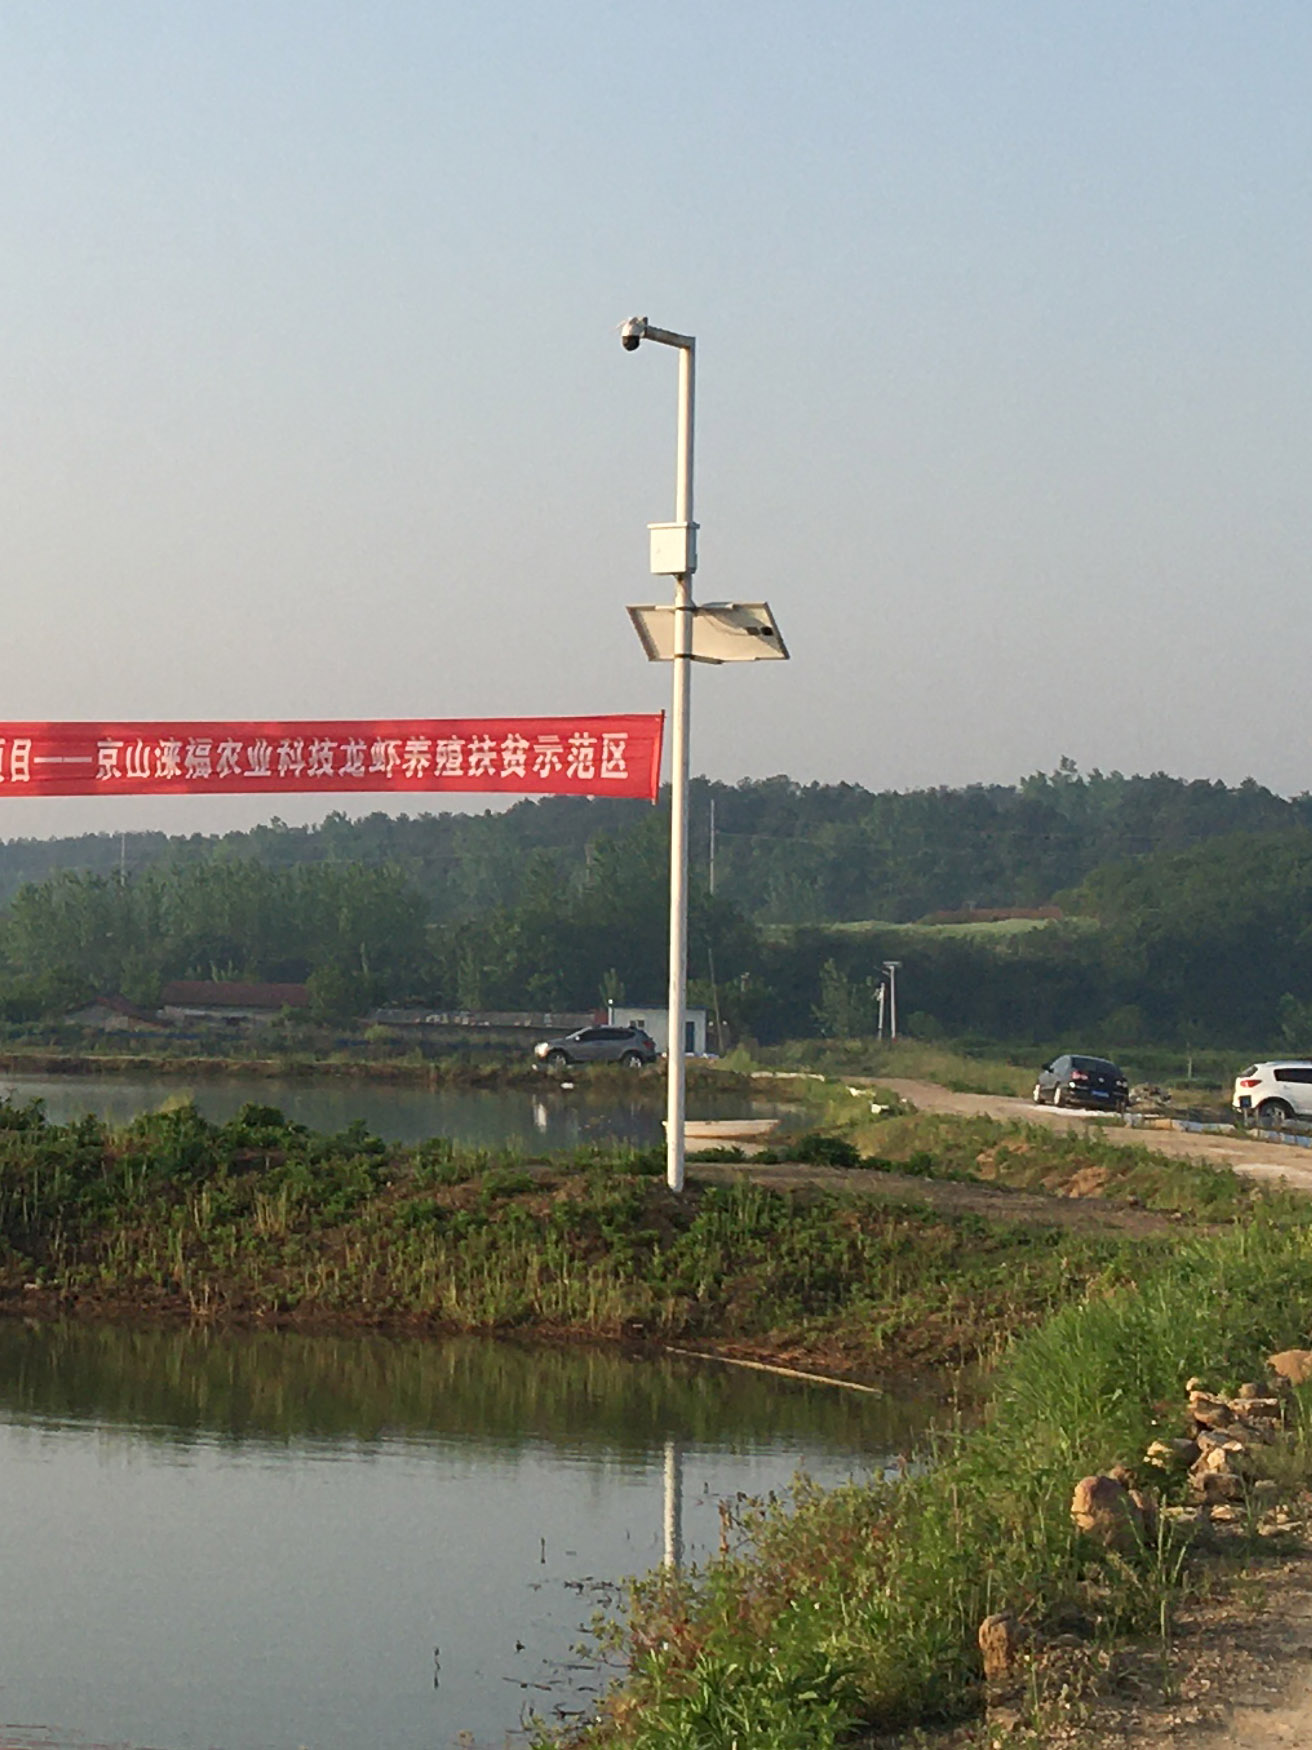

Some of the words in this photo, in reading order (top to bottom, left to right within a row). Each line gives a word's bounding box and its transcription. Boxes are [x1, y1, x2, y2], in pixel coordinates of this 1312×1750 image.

[0, 731, 629, 782] 目——京山涞福农业科技龙虾养殖扶贫示范区
